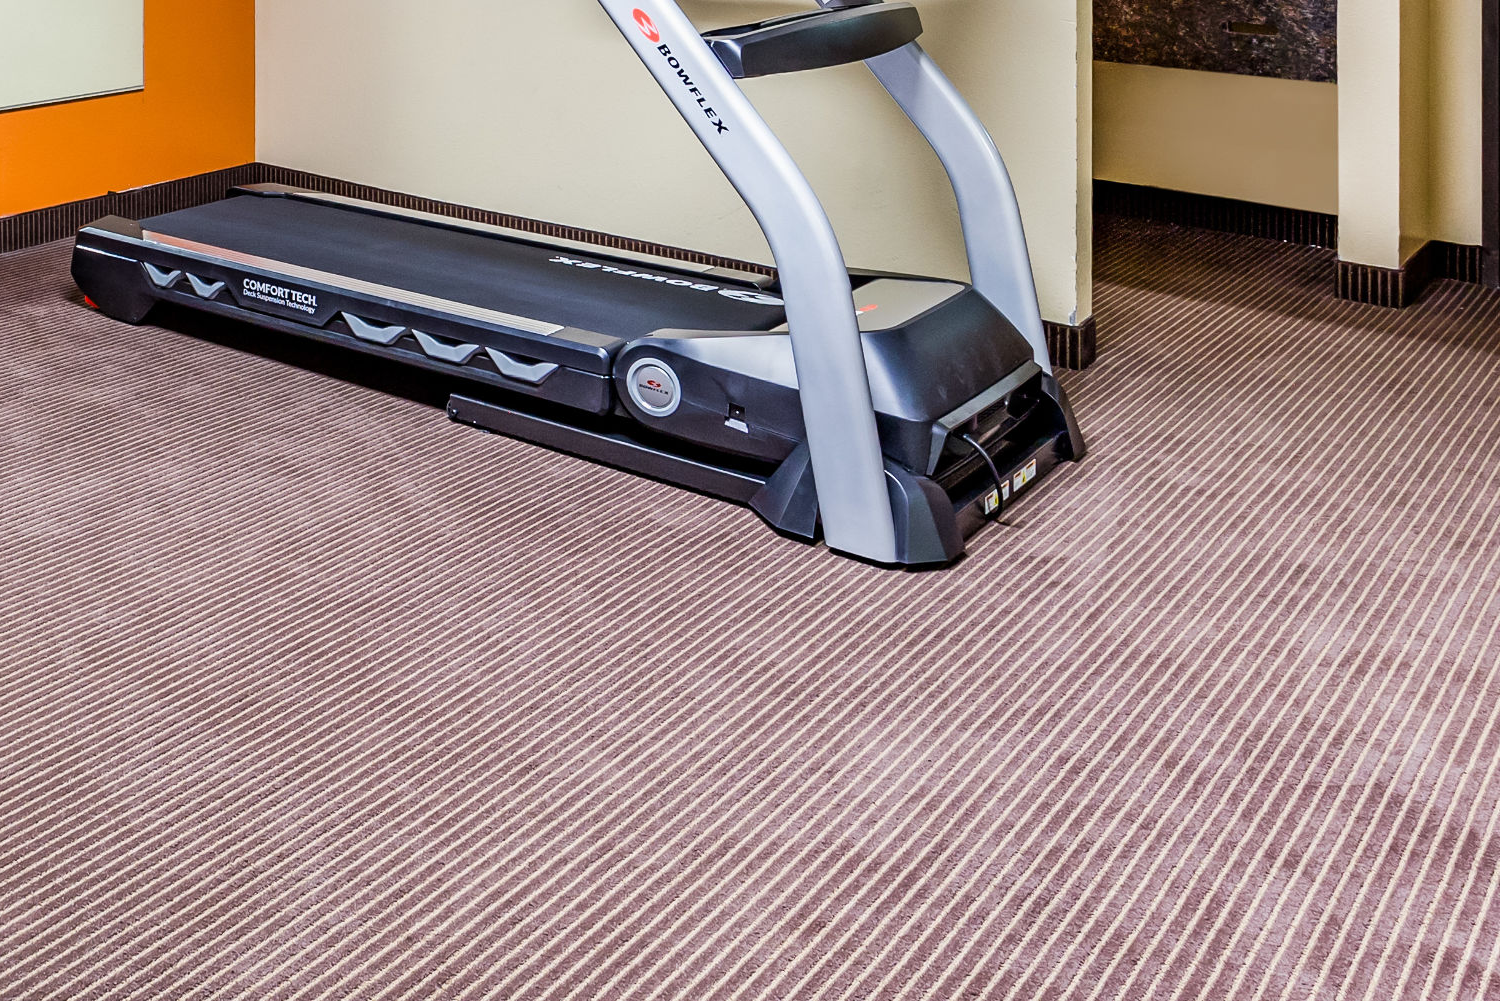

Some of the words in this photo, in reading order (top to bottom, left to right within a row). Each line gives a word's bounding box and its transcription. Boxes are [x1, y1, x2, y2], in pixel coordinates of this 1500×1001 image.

[657, 43, 729, 135] BOWFLEX
[243, 278, 289, 299] COMFORT
[549, 255, 719, 292] BOWFLEX
[243, 288, 256, 298] Deck
[257, 292, 285, 306] Suspension
[286, 300, 316, 315] Technology
